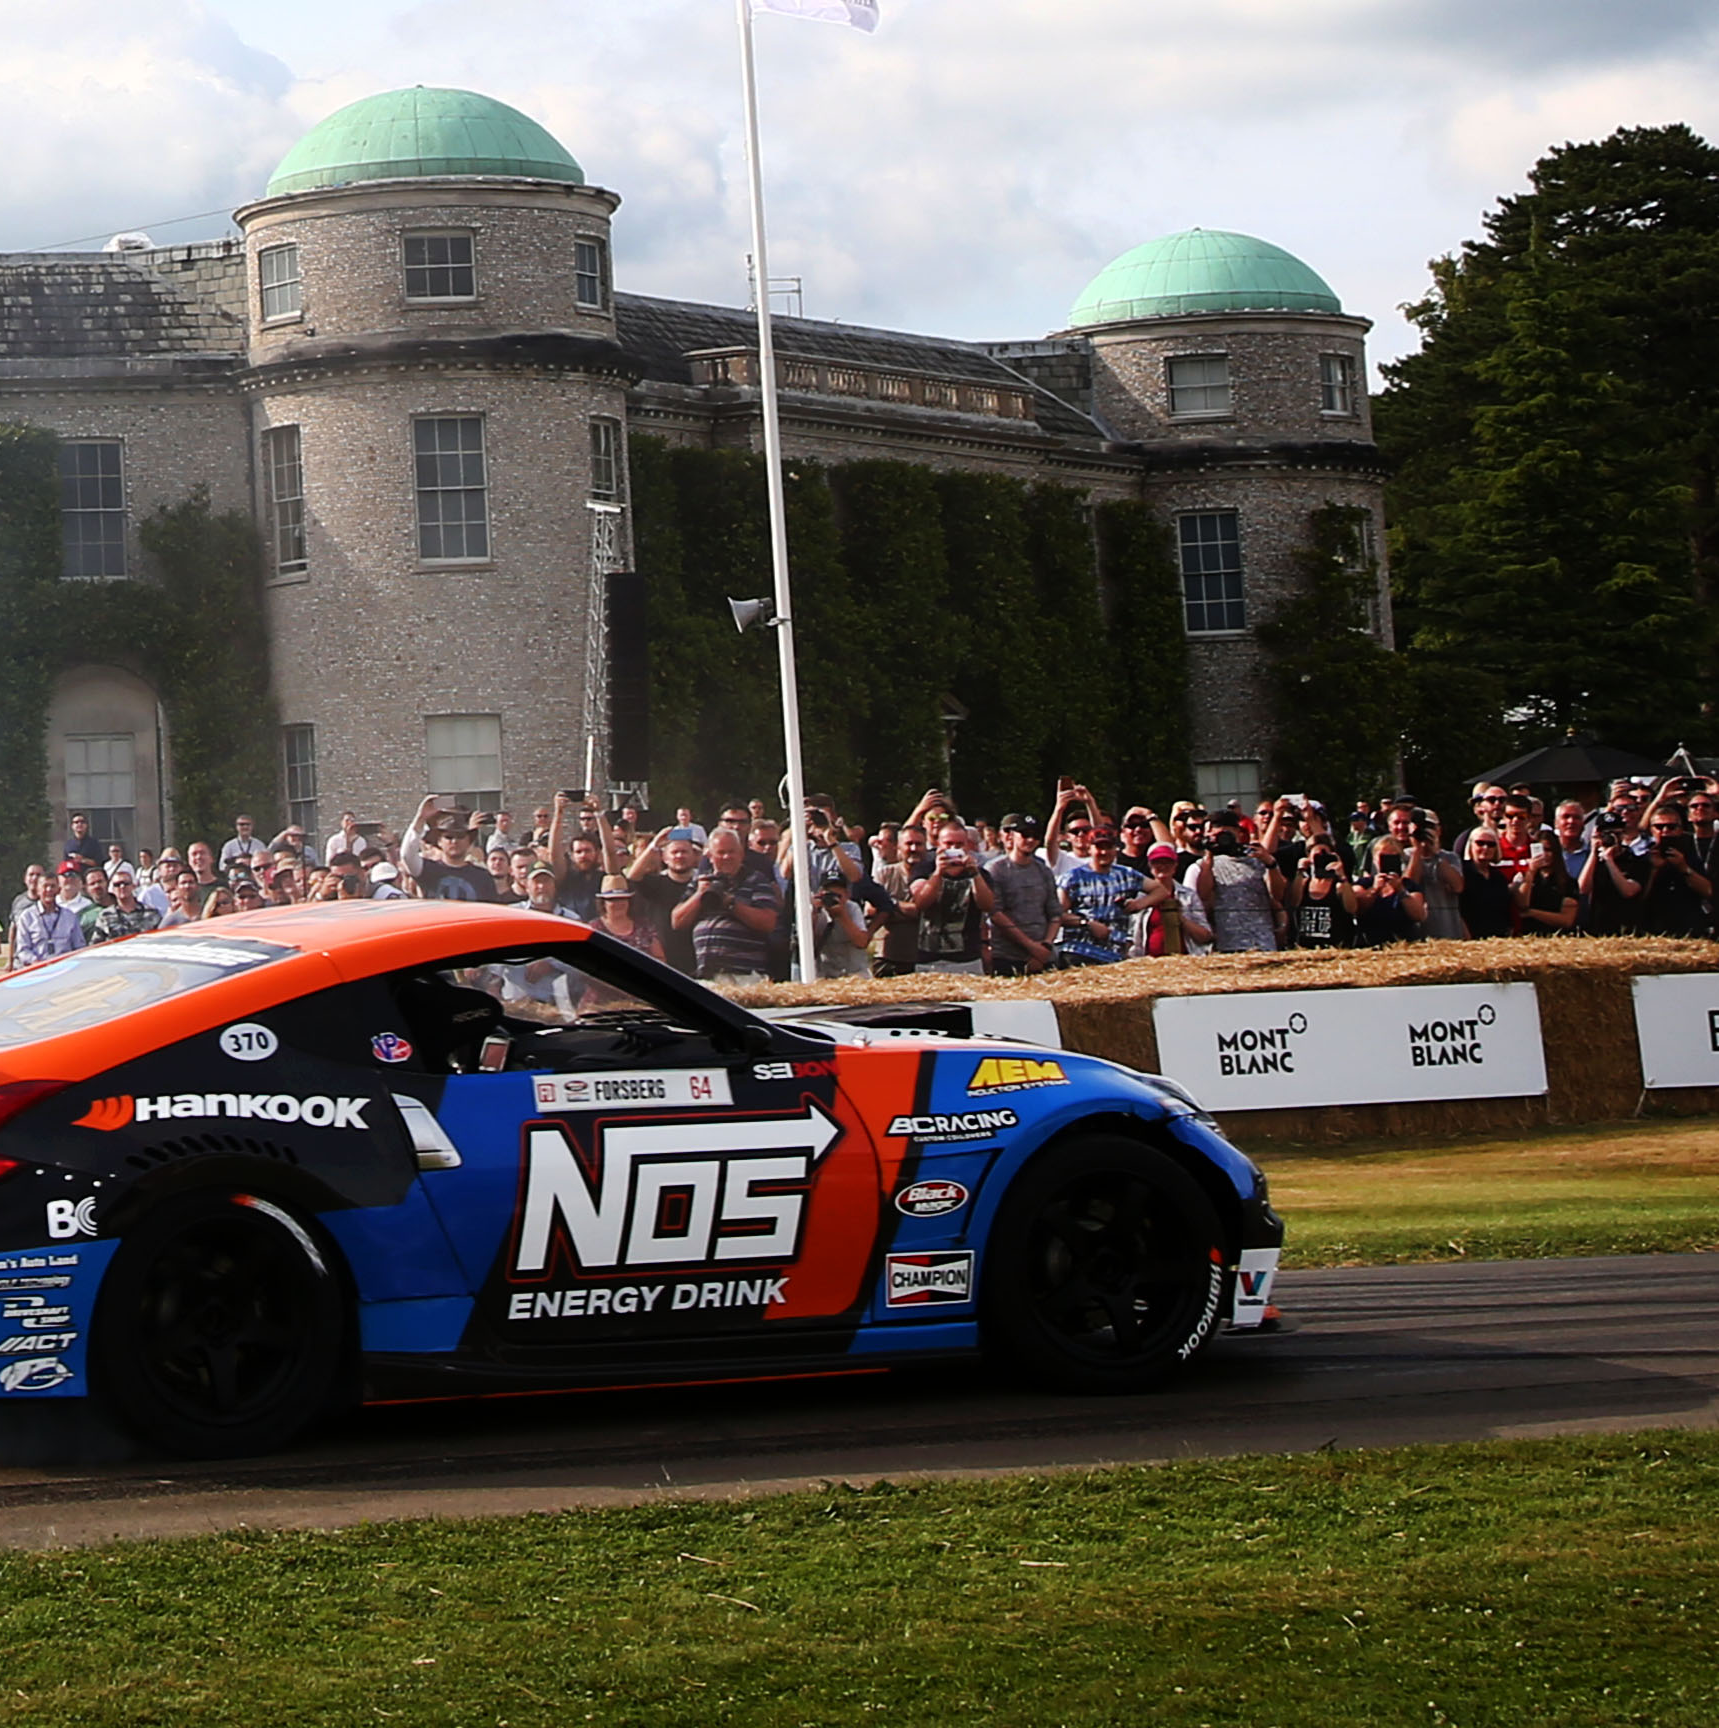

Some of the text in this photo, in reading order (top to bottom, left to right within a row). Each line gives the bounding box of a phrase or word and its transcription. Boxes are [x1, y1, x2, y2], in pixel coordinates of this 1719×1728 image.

[228, 1031, 269, 1052] 370
[1216, 1028, 1290, 1052] MONT
[1408, 1019, 1478, 1043] MONT
[1219, 1052, 1294, 1076] BLANC
[1411, 1043, 1483, 1067] BLANC
[968, 1058, 1067, 1088] AEM
[594, 1078, 666, 1101] FORSBERG
[689, 1075, 712, 1100] 64
[516, 1104, 840, 1271] NOS
[907, 1185, 959, 1202] Black
[20, 1256, 47, 1268] Auto
[48, 1254, 79, 1266] Land
[891, 1269, 967, 1288] CHAMPION
[507, 1277, 792, 1320] ENERGY DRINK
